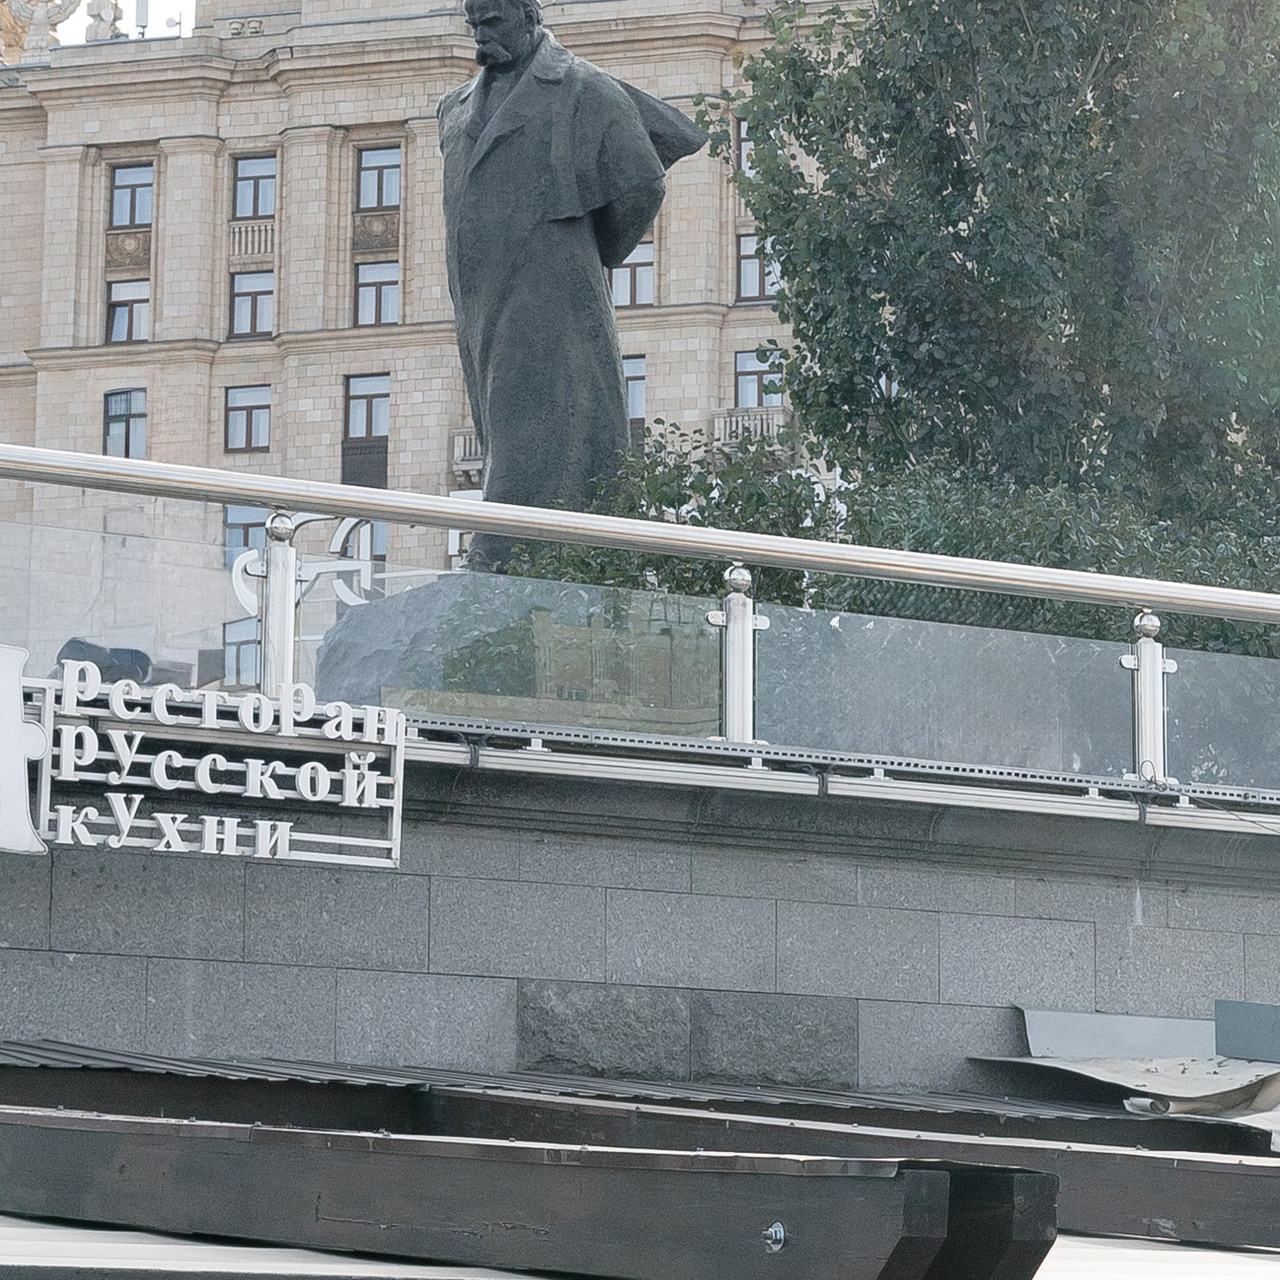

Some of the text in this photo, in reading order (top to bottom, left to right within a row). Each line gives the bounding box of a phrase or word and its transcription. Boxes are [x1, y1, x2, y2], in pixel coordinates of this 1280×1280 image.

[56, 659, 400, 743] ресторан
[55, 725, 381, 808] русской
[54, 793, 294, 858] кухни
